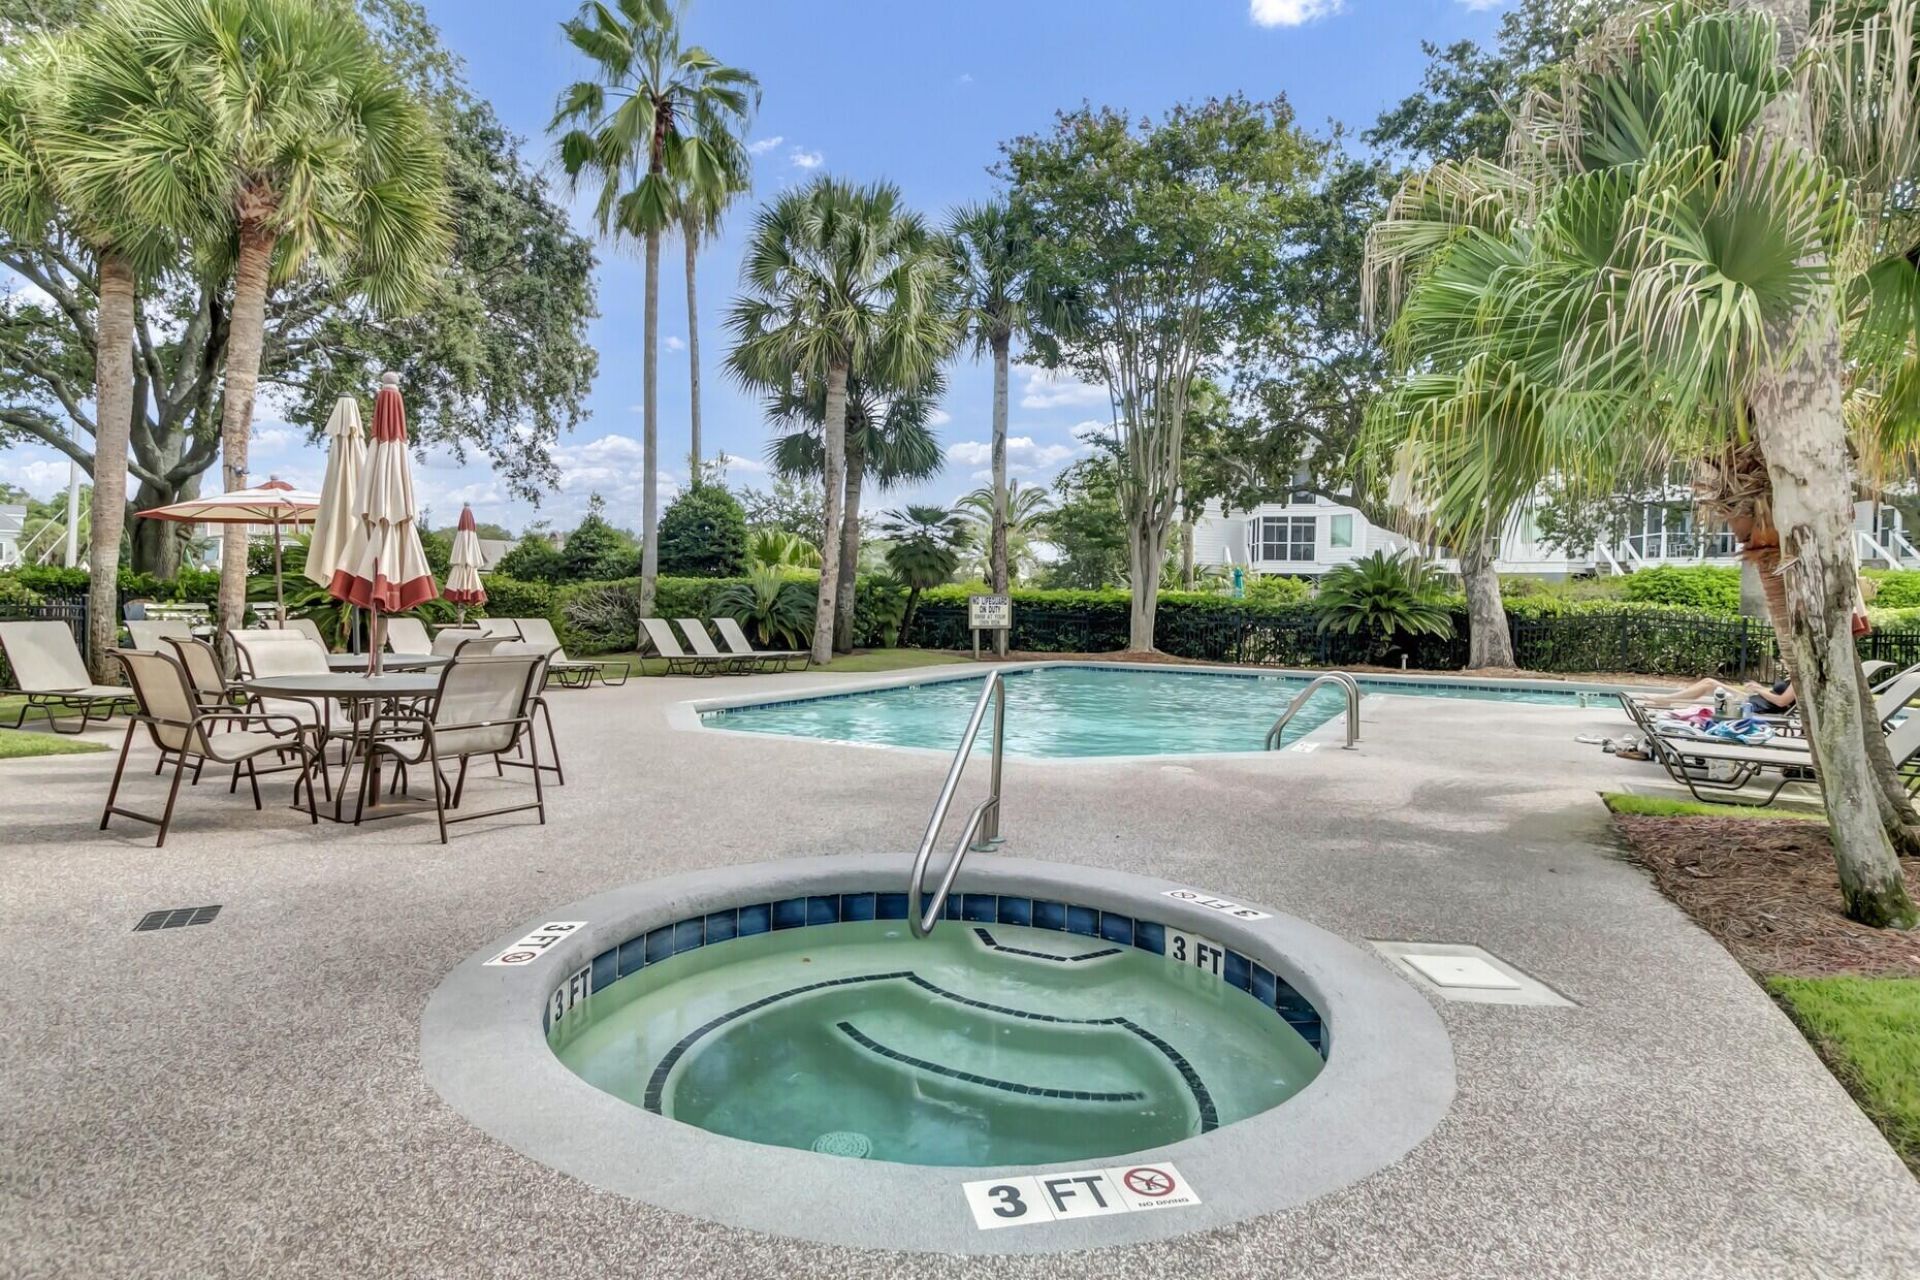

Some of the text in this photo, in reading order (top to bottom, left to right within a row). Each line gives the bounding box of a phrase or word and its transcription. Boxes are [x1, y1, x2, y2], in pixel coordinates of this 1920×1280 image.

[972, 597, 1008, 605] NO LIFEGUARD
[980, 605, 1001, 613] ON DUTY
[1194, 900, 1235, 909] FT
[518, 936, 562, 949] FT
[1172, 936, 1222, 975] 3 FT
[555, 967, 591, 1022] 3 FT
[988, 1175, 1109, 1218] 3 FT
[1156, 1198, 1190, 1206] DIVING
